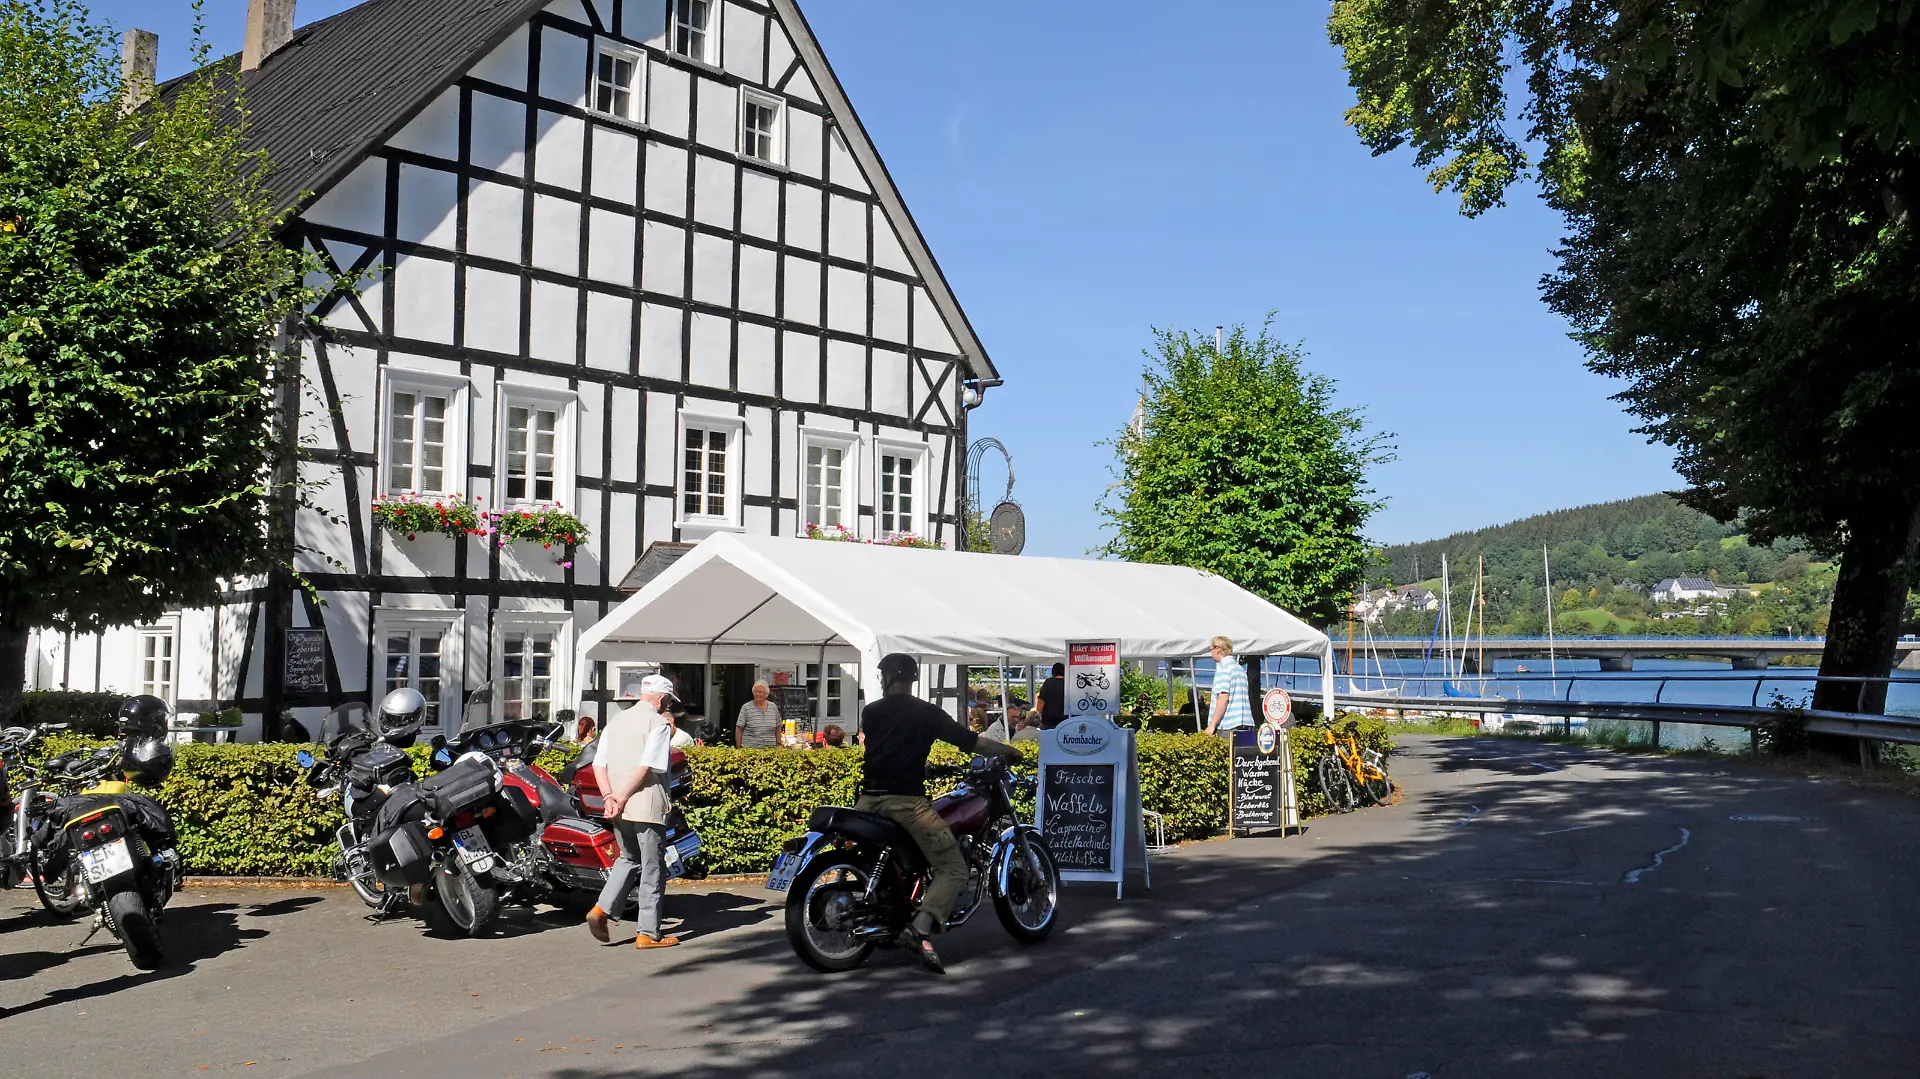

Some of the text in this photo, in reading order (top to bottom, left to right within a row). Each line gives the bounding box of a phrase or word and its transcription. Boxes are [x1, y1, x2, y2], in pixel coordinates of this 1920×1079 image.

[1063, 734, 1103, 745] Krombacher
[1055, 769, 1105, 785] Frische
[1047, 793, 1108, 814] Waffeln
[461, 830, 474, 840] GL
